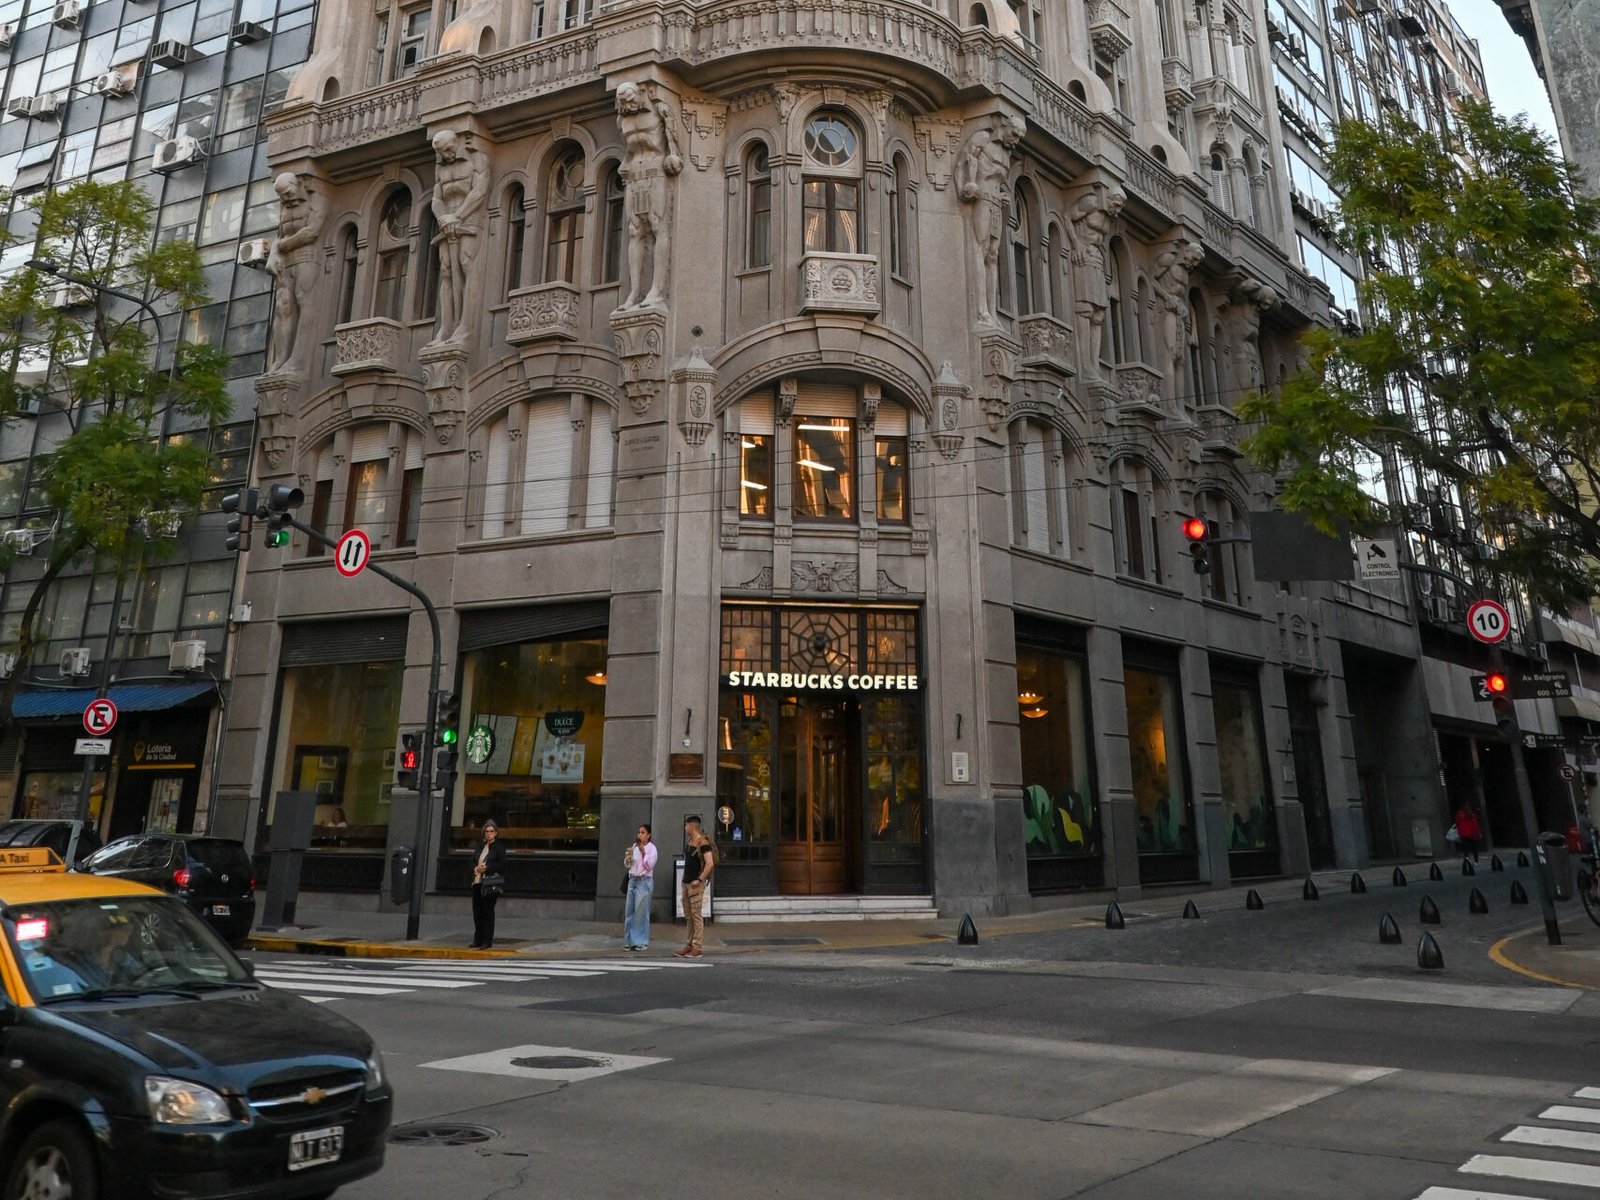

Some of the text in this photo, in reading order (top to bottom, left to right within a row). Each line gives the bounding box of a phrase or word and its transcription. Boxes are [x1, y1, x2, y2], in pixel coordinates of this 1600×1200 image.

[1476, 612, 1500, 631] 10
[729, 671, 918, 690] STARBUCKS COFFEE
[1534, 674, 1565, 682] Belgrano
[159, 752, 177, 760] Ciudad
[8, 852, 30, 864] Taxi
